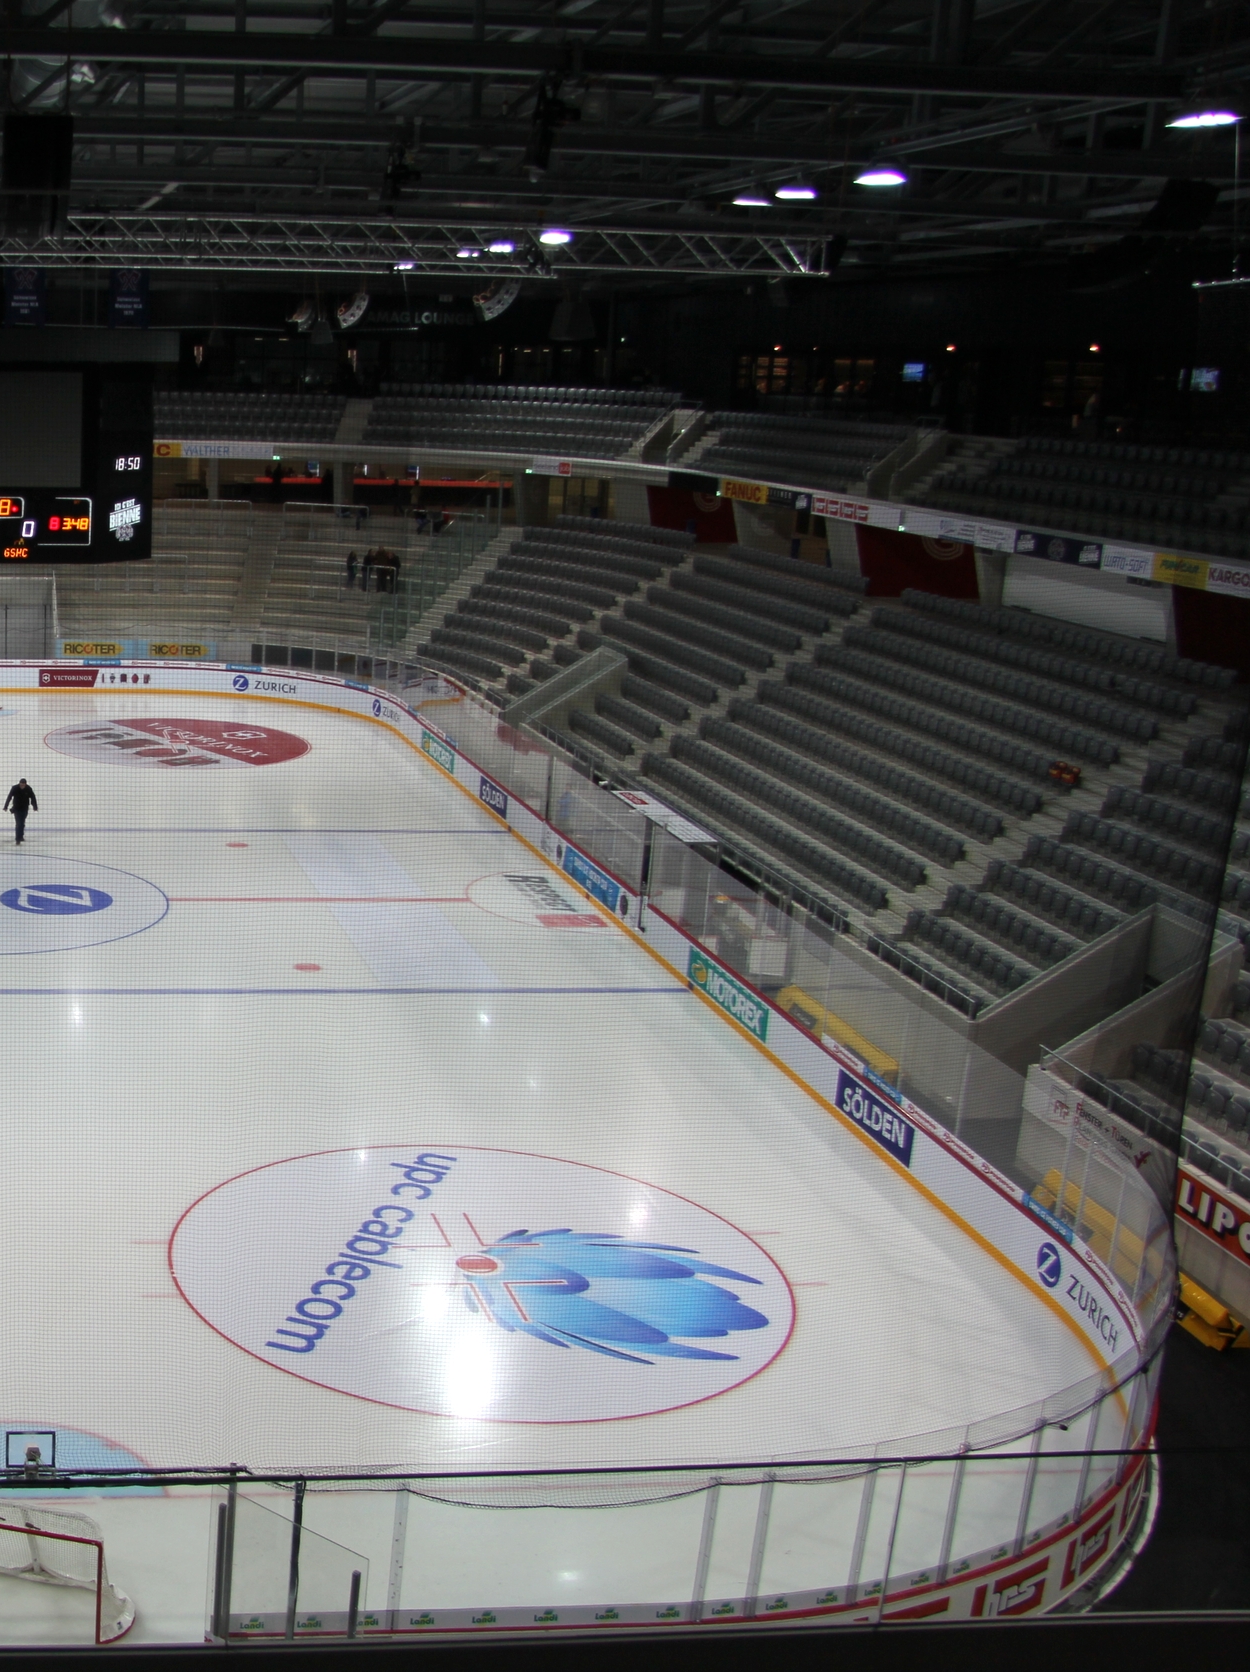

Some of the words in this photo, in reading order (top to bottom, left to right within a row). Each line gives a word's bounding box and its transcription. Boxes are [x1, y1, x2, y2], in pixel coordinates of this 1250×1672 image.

[114, 457, 141, 471] 18:50
[724, 481, 761, 502] FANUC
[109, 506, 142, 527] BIENNE
[22, 520, 35, 538] 0
[4, 547, 29, 559] GSHC
[63, 643, 116, 655] RICOTER
[150, 644, 201, 656] RICOTER
[254, 680, 297, 695] ZURICH
[481, 783, 505, 810] SÖLDEN
[706, 969, 764, 1035] MOTOREX
[843, 1086, 907, 1149] SÖLDEN
[390, 1152, 457, 1202] upc
[265, 1204, 414, 1355] cablecom
[1065, 1273, 1119, 1353] ZURICH
[910, 1575, 930, 1586] Landi
[816, 1594, 838, 1605] Landi
[711, 1606, 735, 1616] Landi
[765, 1601, 788, 1611] Landi
[472, 1615, 496, 1625] Landi
[534, 1613, 559, 1623] Landi
[595, 1611, 619, 1621] Landi
[656, 1609, 680, 1619] Landi
[240, 1621, 264, 1630] Landi
[296, 1620, 322, 1629] Landi
[410, 1617, 435, 1626] Landi
